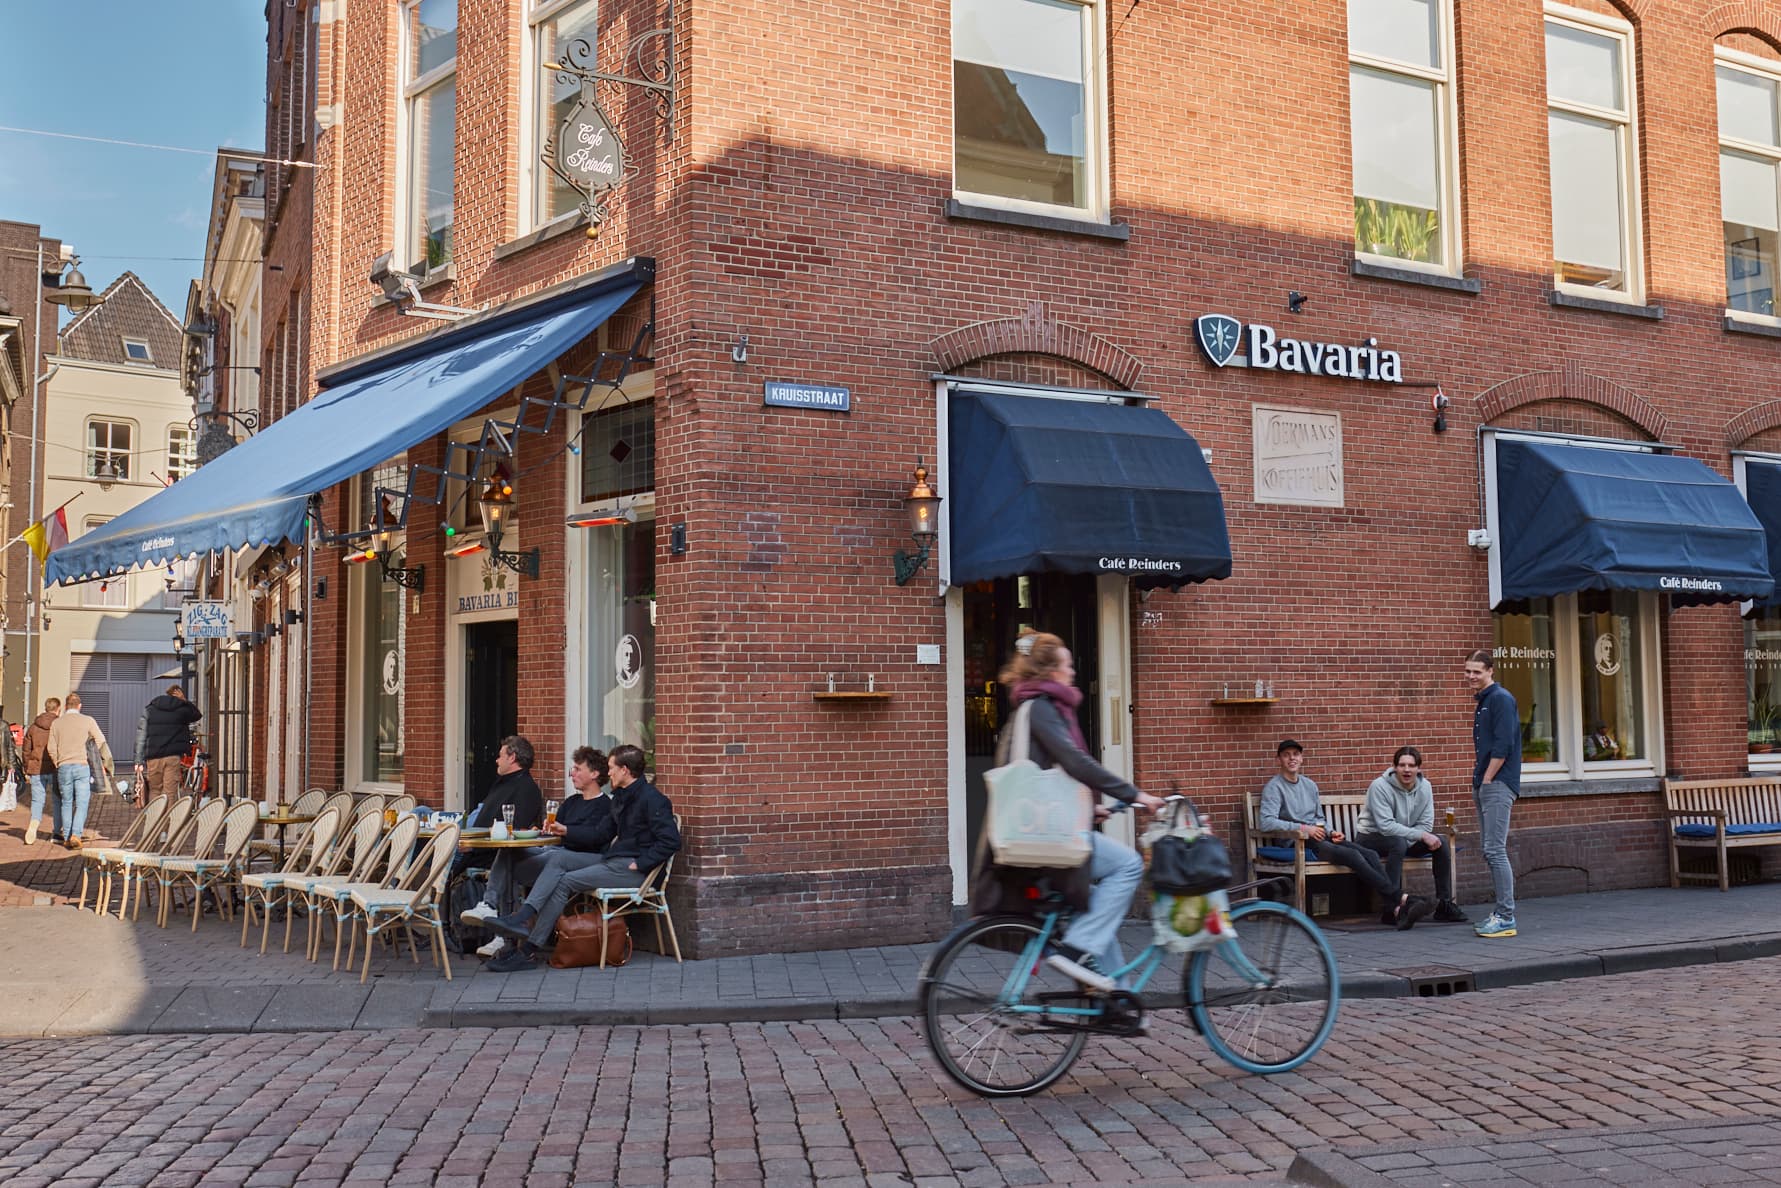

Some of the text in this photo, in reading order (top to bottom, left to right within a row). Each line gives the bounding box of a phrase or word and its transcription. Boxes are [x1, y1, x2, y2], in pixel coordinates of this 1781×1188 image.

[567, 148, 614, 175] Reinders
[1248, 323, 1404, 383] Bavaria
[771, 387, 845, 406] KRUISSTRAAT
[1098, 557, 1181, 571] Café Reinders
[1660, 576, 1722, 591] Café Reinders
[458, 593, 502, 611] BAVARIA
[1510, 646, 1555, 659] Reinders
